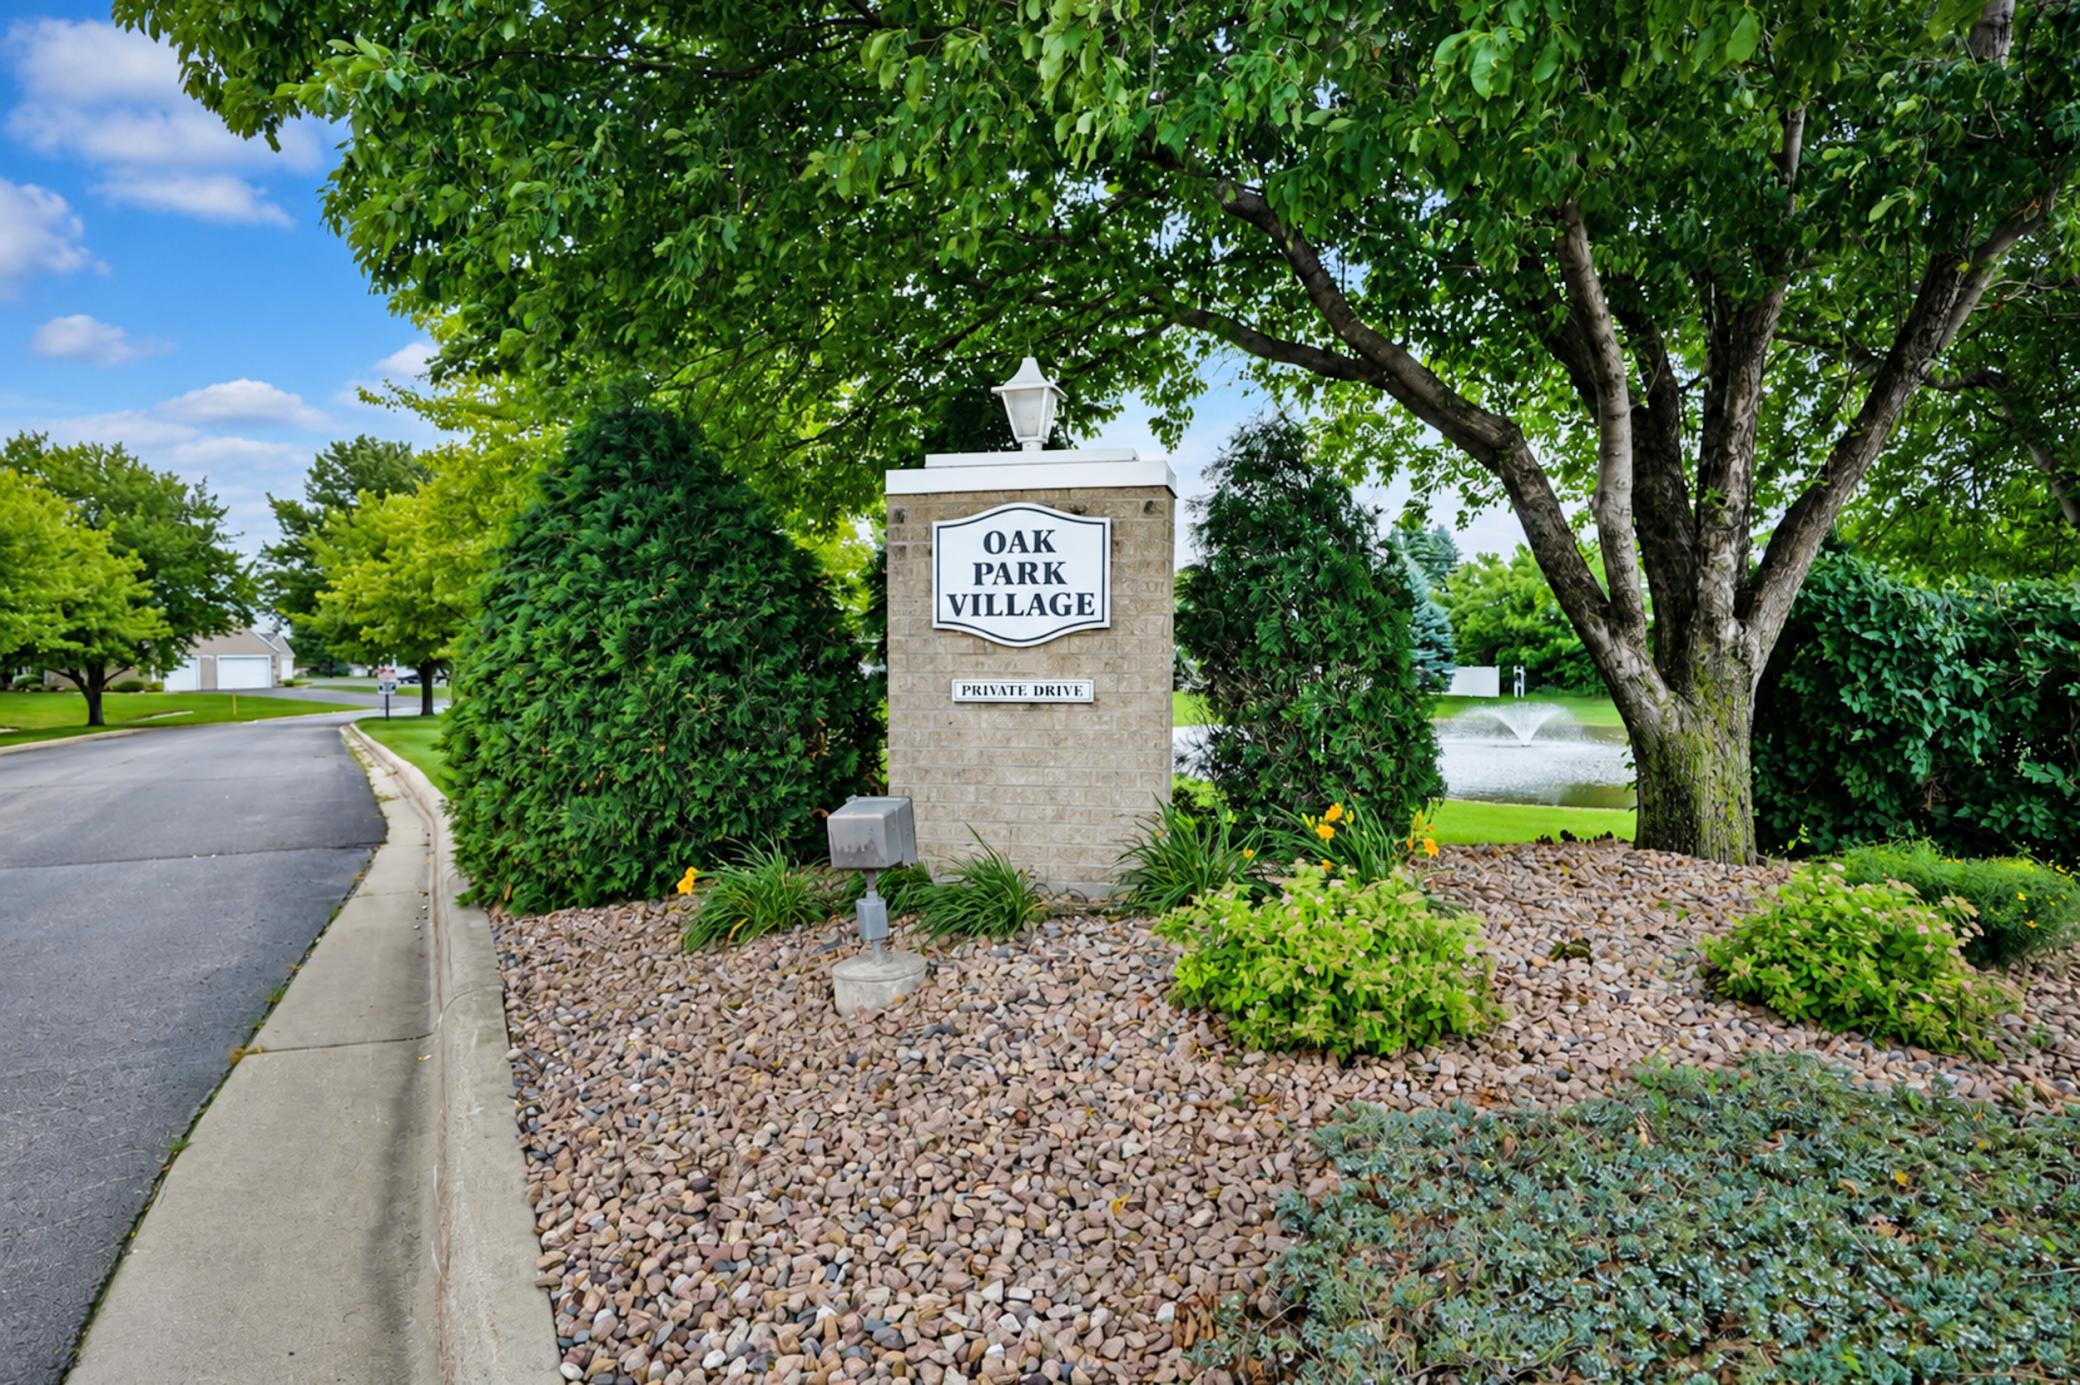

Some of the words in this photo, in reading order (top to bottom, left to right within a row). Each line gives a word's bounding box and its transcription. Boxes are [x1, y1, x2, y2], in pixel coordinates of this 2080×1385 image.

[983, 529, 1056, 555] OAK
[973, 561, 1068, 586] PARK
[946, 592, 1095, 617] VILLAGE
[961, 684, 1028, 697] PRIVATE
[1034, 684, 1084, 697] DRIVE
